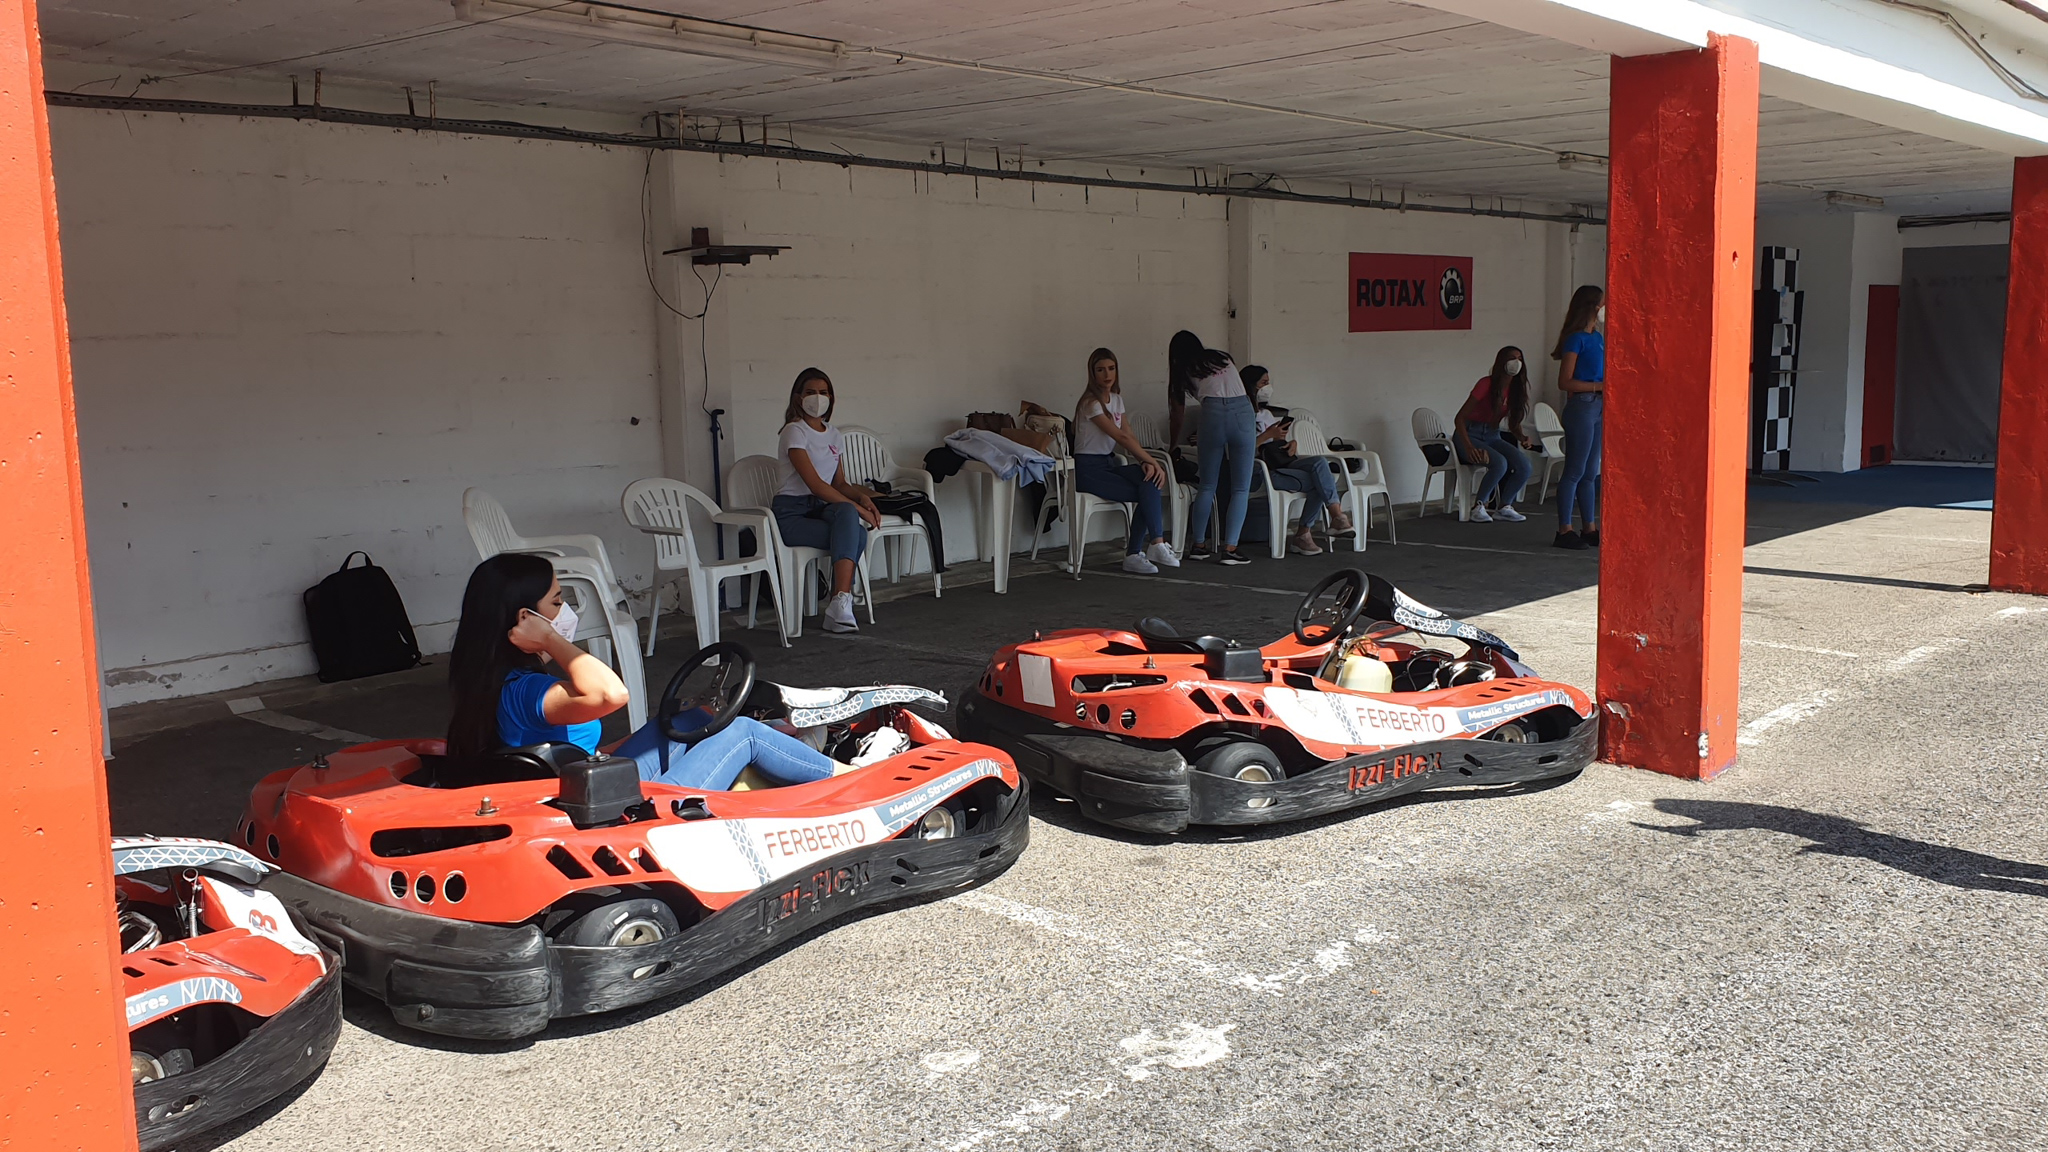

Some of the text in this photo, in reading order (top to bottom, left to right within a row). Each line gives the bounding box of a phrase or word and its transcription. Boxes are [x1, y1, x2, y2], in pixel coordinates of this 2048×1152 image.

[1356, 278, 1426, 308] ROTAX
[1449, 295, 1464, 304] BRP
[1356, 707, 1445, 734] FERBERTO
[1467, 696, 1546, 721] Metallic Structures
[889, 769, 973, 818] Metallic Structures
[764, 819, 866, 858] FERBERTO
